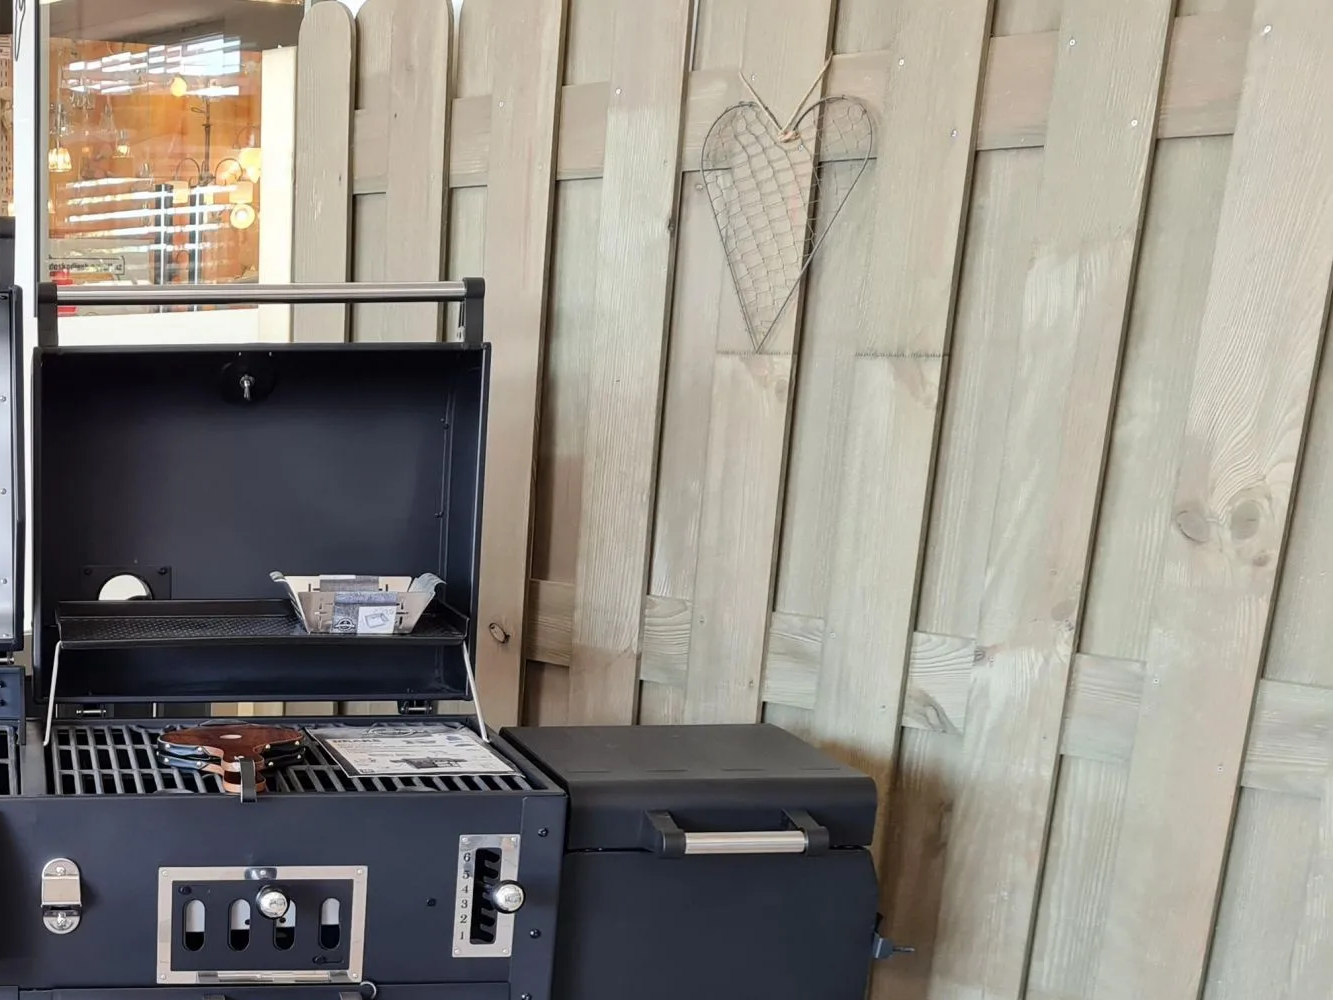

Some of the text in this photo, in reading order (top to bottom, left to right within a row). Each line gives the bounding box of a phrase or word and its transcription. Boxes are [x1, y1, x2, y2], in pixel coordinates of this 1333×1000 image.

[463, 853, 471, 862] 6
[462, 870, 470, 880] 5
[462, 885, 469, 894] 4
[460, 899, 468, 909] 3
[460, 914, 468, 923] 2
[459, 931, 465, 940] 1
